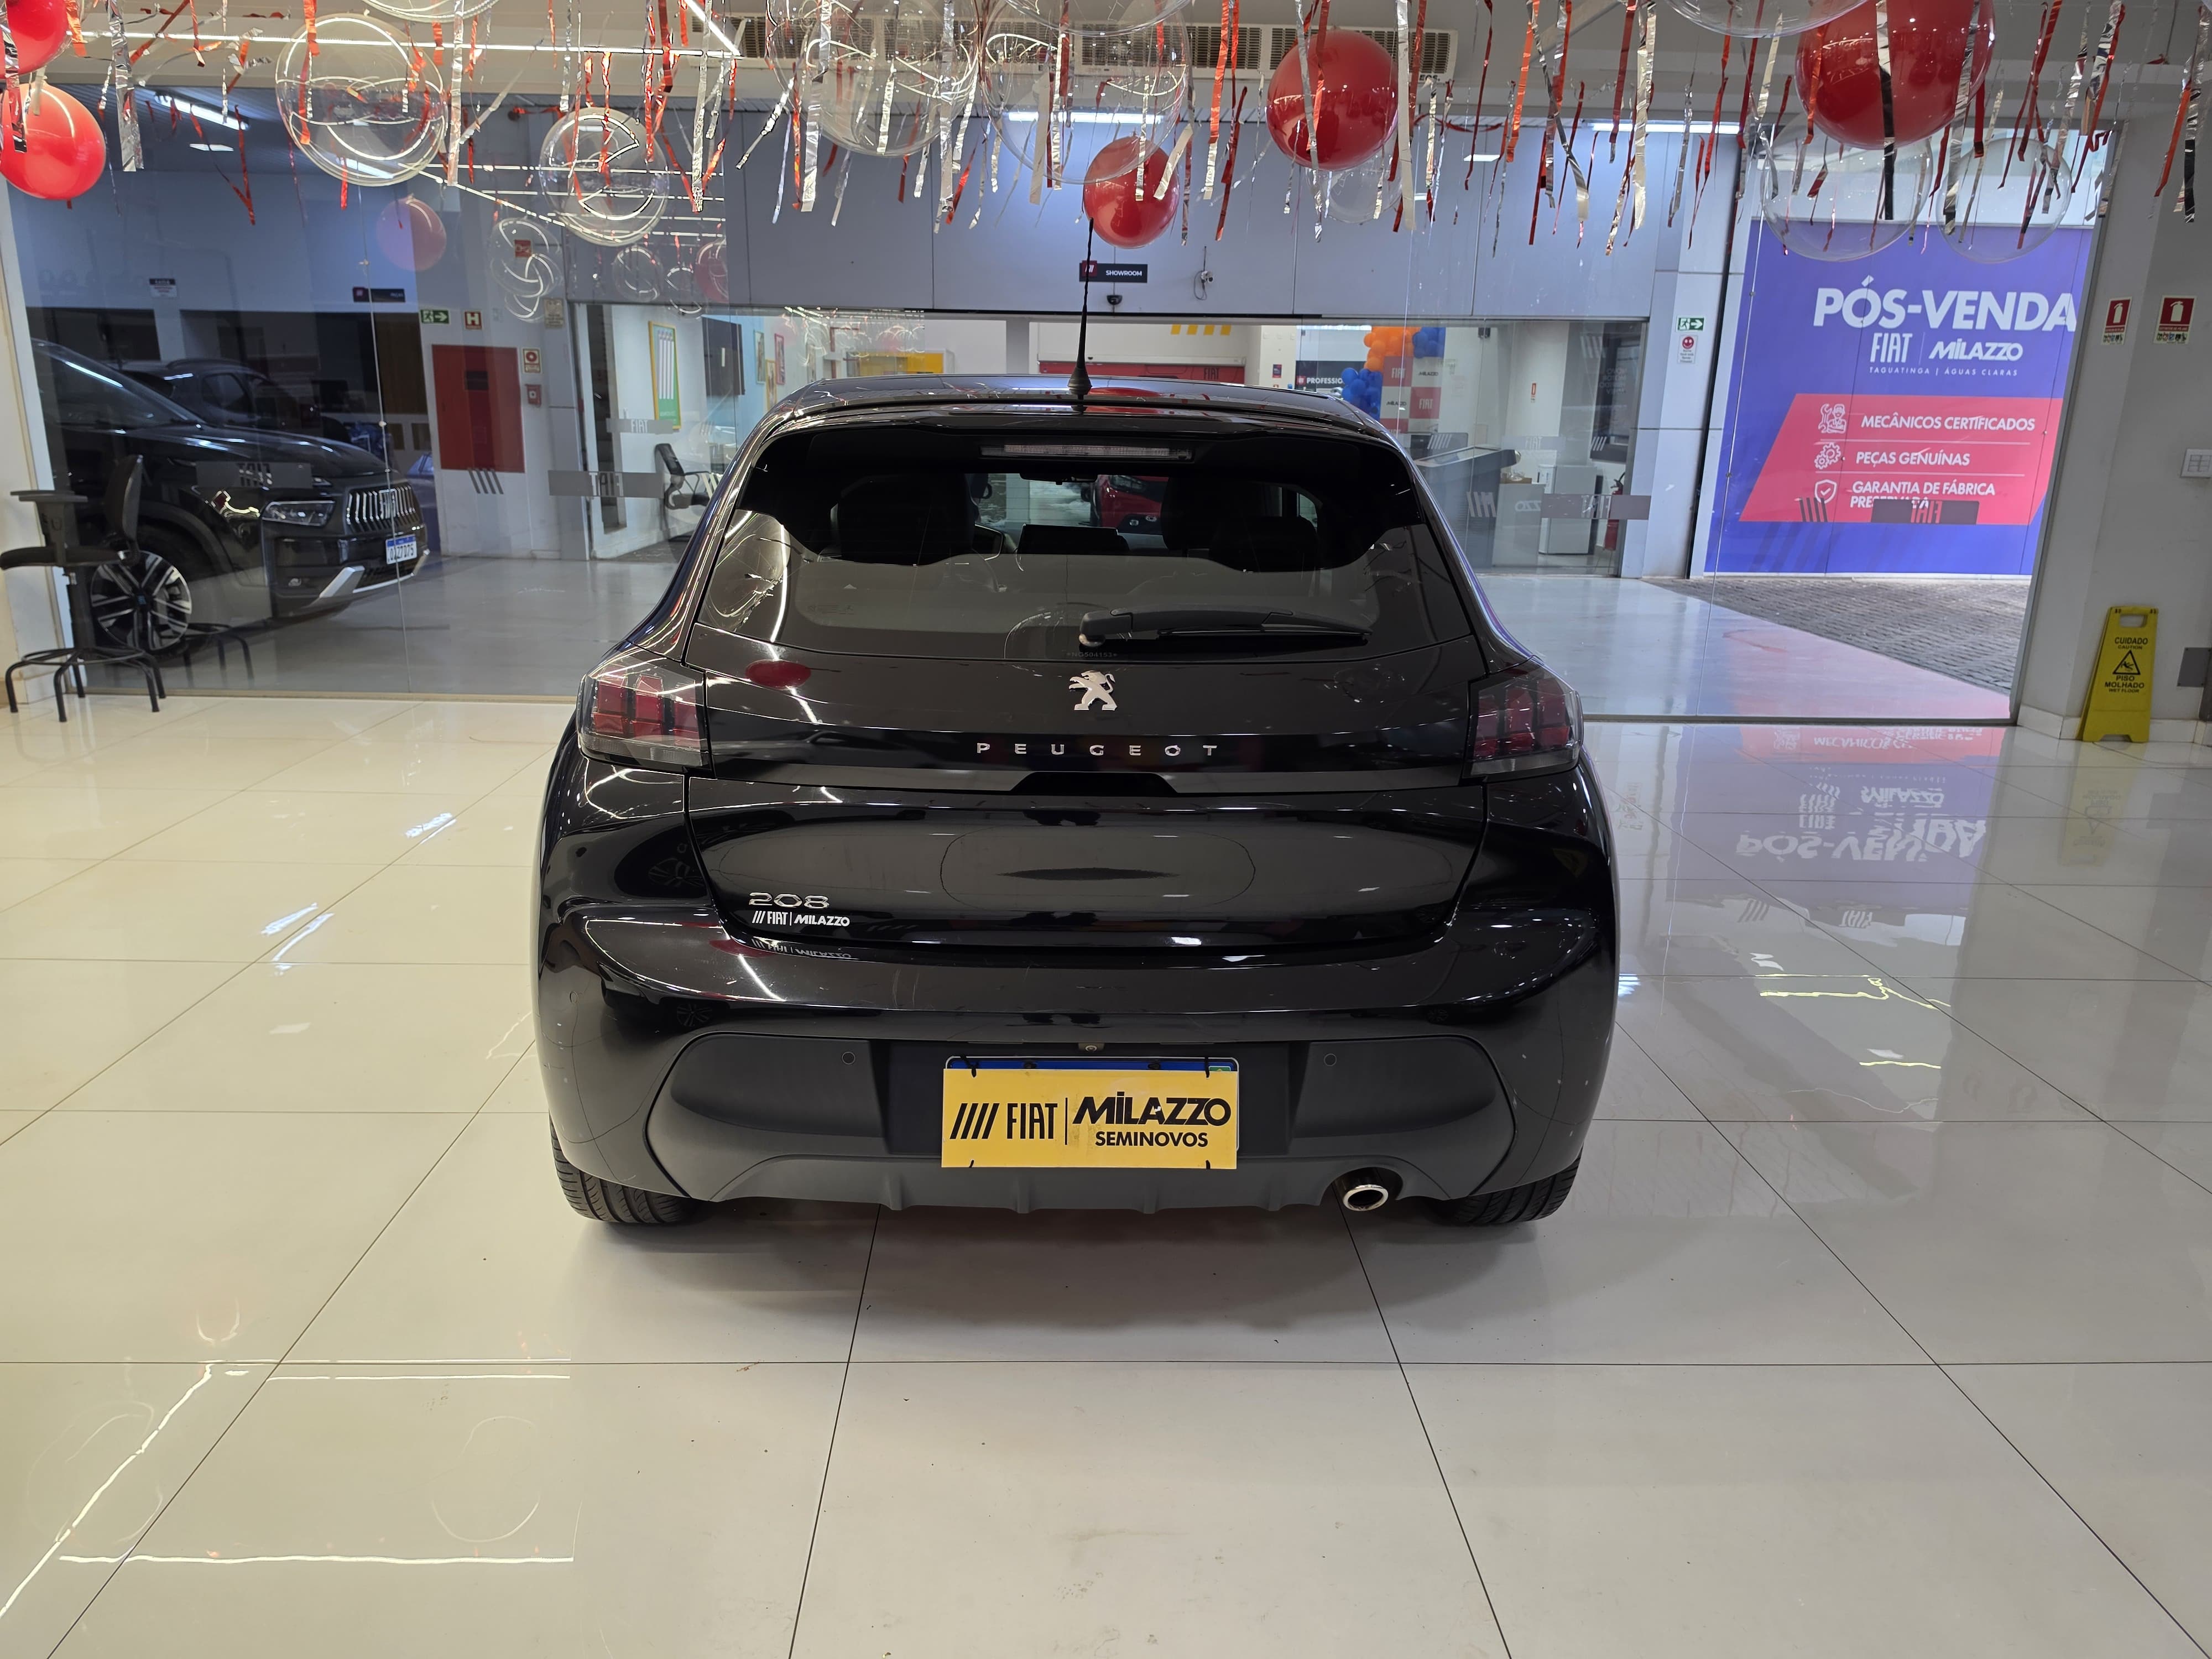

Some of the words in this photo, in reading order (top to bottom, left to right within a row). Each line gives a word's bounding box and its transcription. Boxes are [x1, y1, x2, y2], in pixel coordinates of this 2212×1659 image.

[1813, 275, 2077, 332] PÓS-VENDA
[1870, 332, 1913, 363] FIAT
[1928, 338, 2023, 361] MILAZZO
[1944, 366, 1976, 375] ÁGUAS
[1981, 368, 2018, 377] CLARAS
[1419, 398, 1433, 409] FIAT
[630, 419, 648, 433] FIAT
[1861, 412, 1942, 429] MECÂNICOS
[1944, 415, 2036, 431] CERTIFICADOS
[1856, 451, 1896, 467] PEÇAS
[1898, 450, 1970, 466] GENUÍNAS
[1852, 481, 1920, 494] GARANTIA
[1923, 482, 1940, 495] DE
[1942, 479, 1995, 496] FÁBRICA
[976, 743, 1217, 757] PEUGEOT
[748, 891, 830, 910] 208
[767, 911, 788, 926] FIAT
[794, 914, 851, 927] MILAZZO
[1006, 1102, 1058, 1139] FIAT
[1072, 1091, 1231, 1126] MILAZZO
[1095, 1131, 1208, 1147] SEMINOVOS
